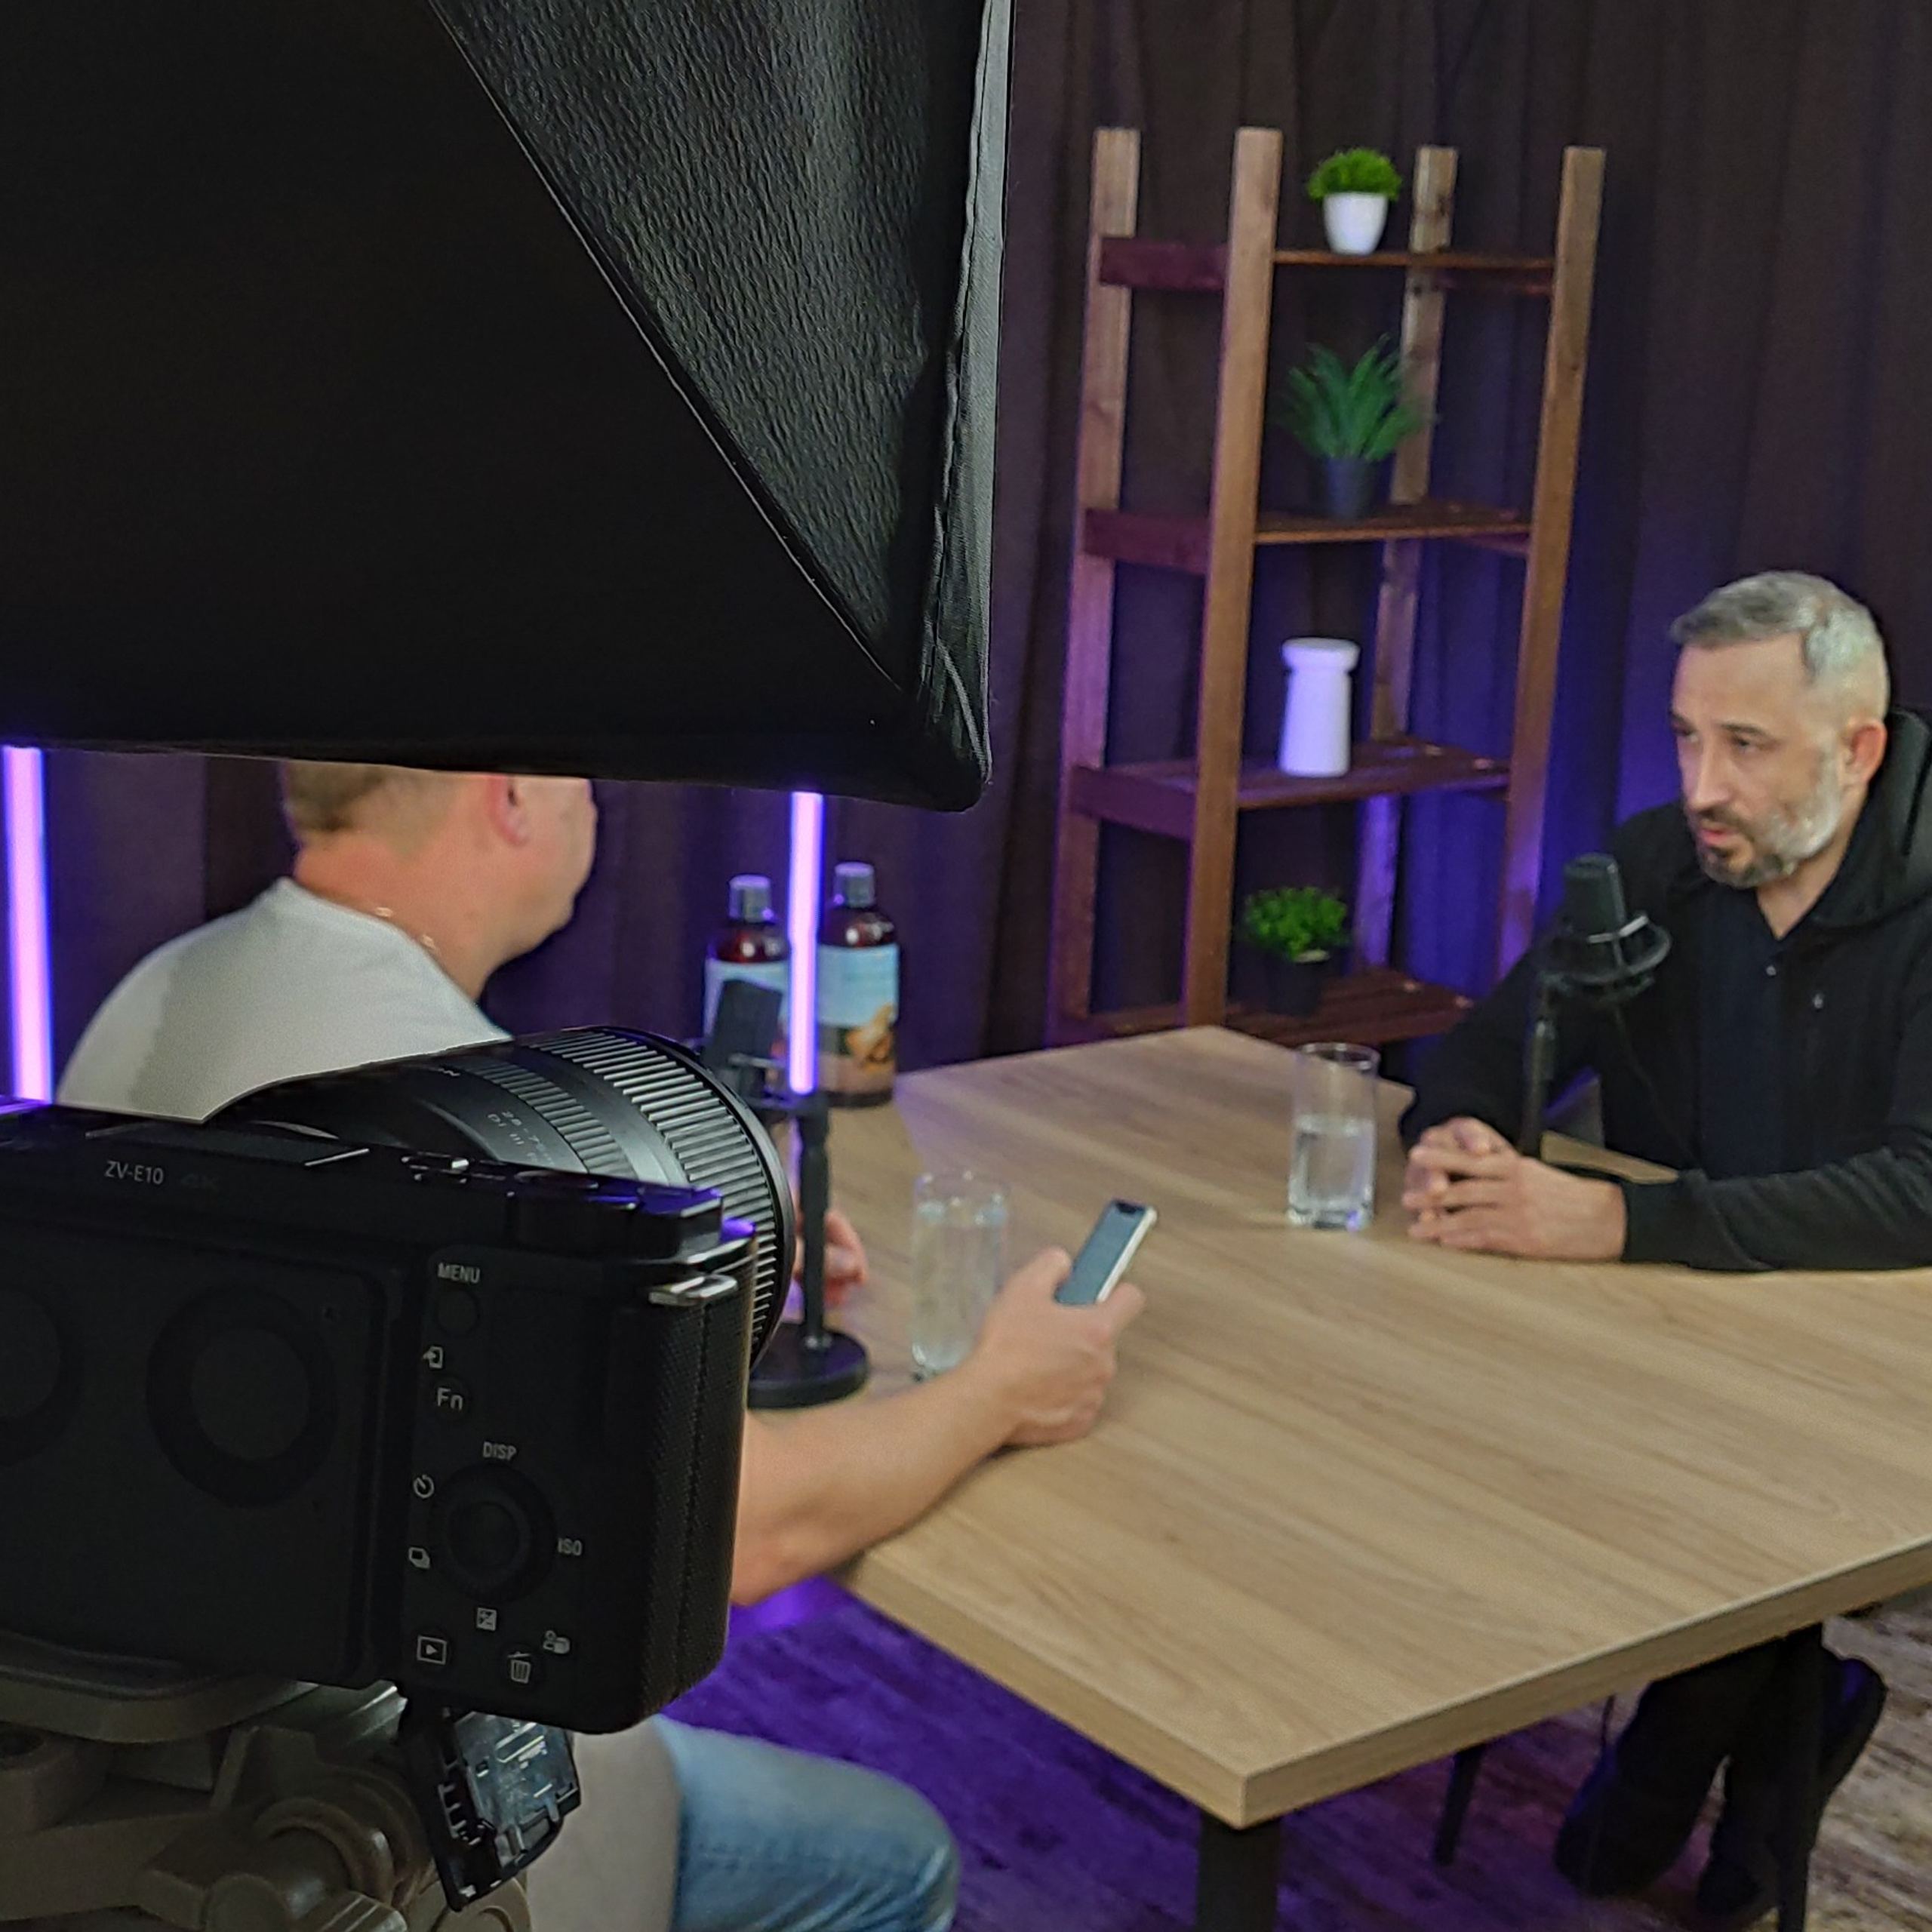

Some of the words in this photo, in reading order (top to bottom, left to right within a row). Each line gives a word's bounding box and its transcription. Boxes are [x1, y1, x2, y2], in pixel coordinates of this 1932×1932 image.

[105, 1160, 164, 1185] ZV-E10
[438, 1263, 481, 1284] MENU
[437, 1387, 463, 1411] Fn
[482, 1441, 517, 1460] DISP
[557, 1537, 583, 1556] ISO
